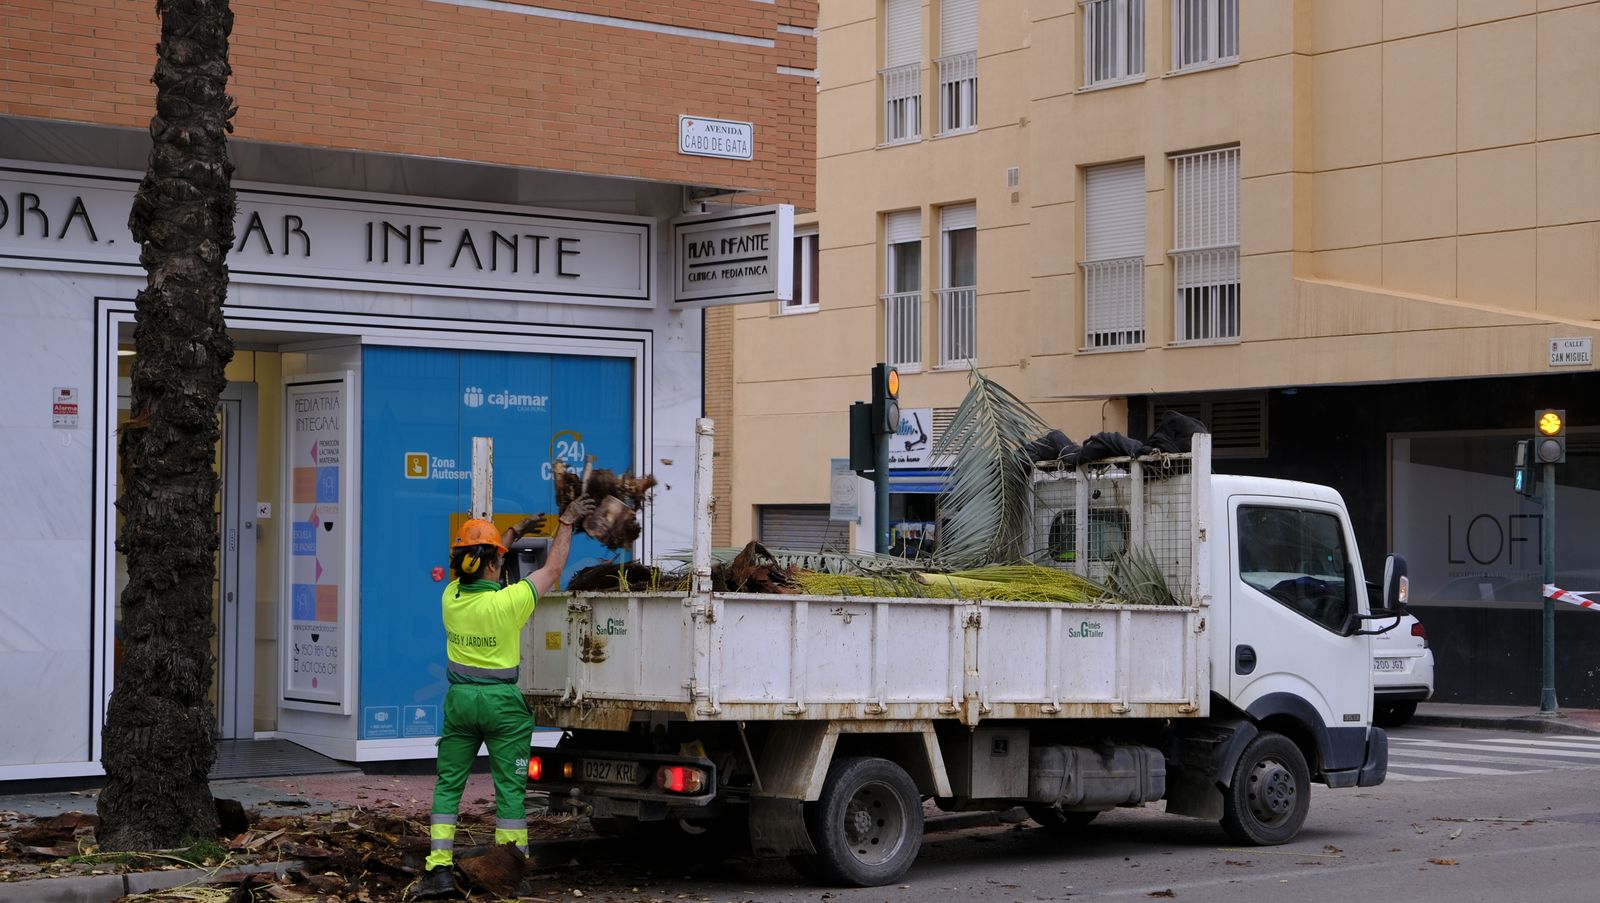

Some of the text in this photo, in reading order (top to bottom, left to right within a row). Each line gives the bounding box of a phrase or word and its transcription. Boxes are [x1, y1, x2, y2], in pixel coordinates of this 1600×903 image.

[704, 125, 743, 136] AVENIDA
[685, 134, 748, 154] CABO DE GATA
[366, 221, 581, 278] INFANTE
[688, 233, 769, 259] PILAR INFANTE
[1551, 352, 1589, 363] SAN MIGUEL
[295, 396, 340, 413] PEDIATRIA
[487, 390, 549, 409] cajamar
[295, 416, 340, 432] INTEGRAL
[431, 457, 455, 468] Zona
[1447, 513, 1544, 566] LOFT
[466, 635, 497, 647] JARDINES
[585, 761, 637, 782] 0327 KRL
